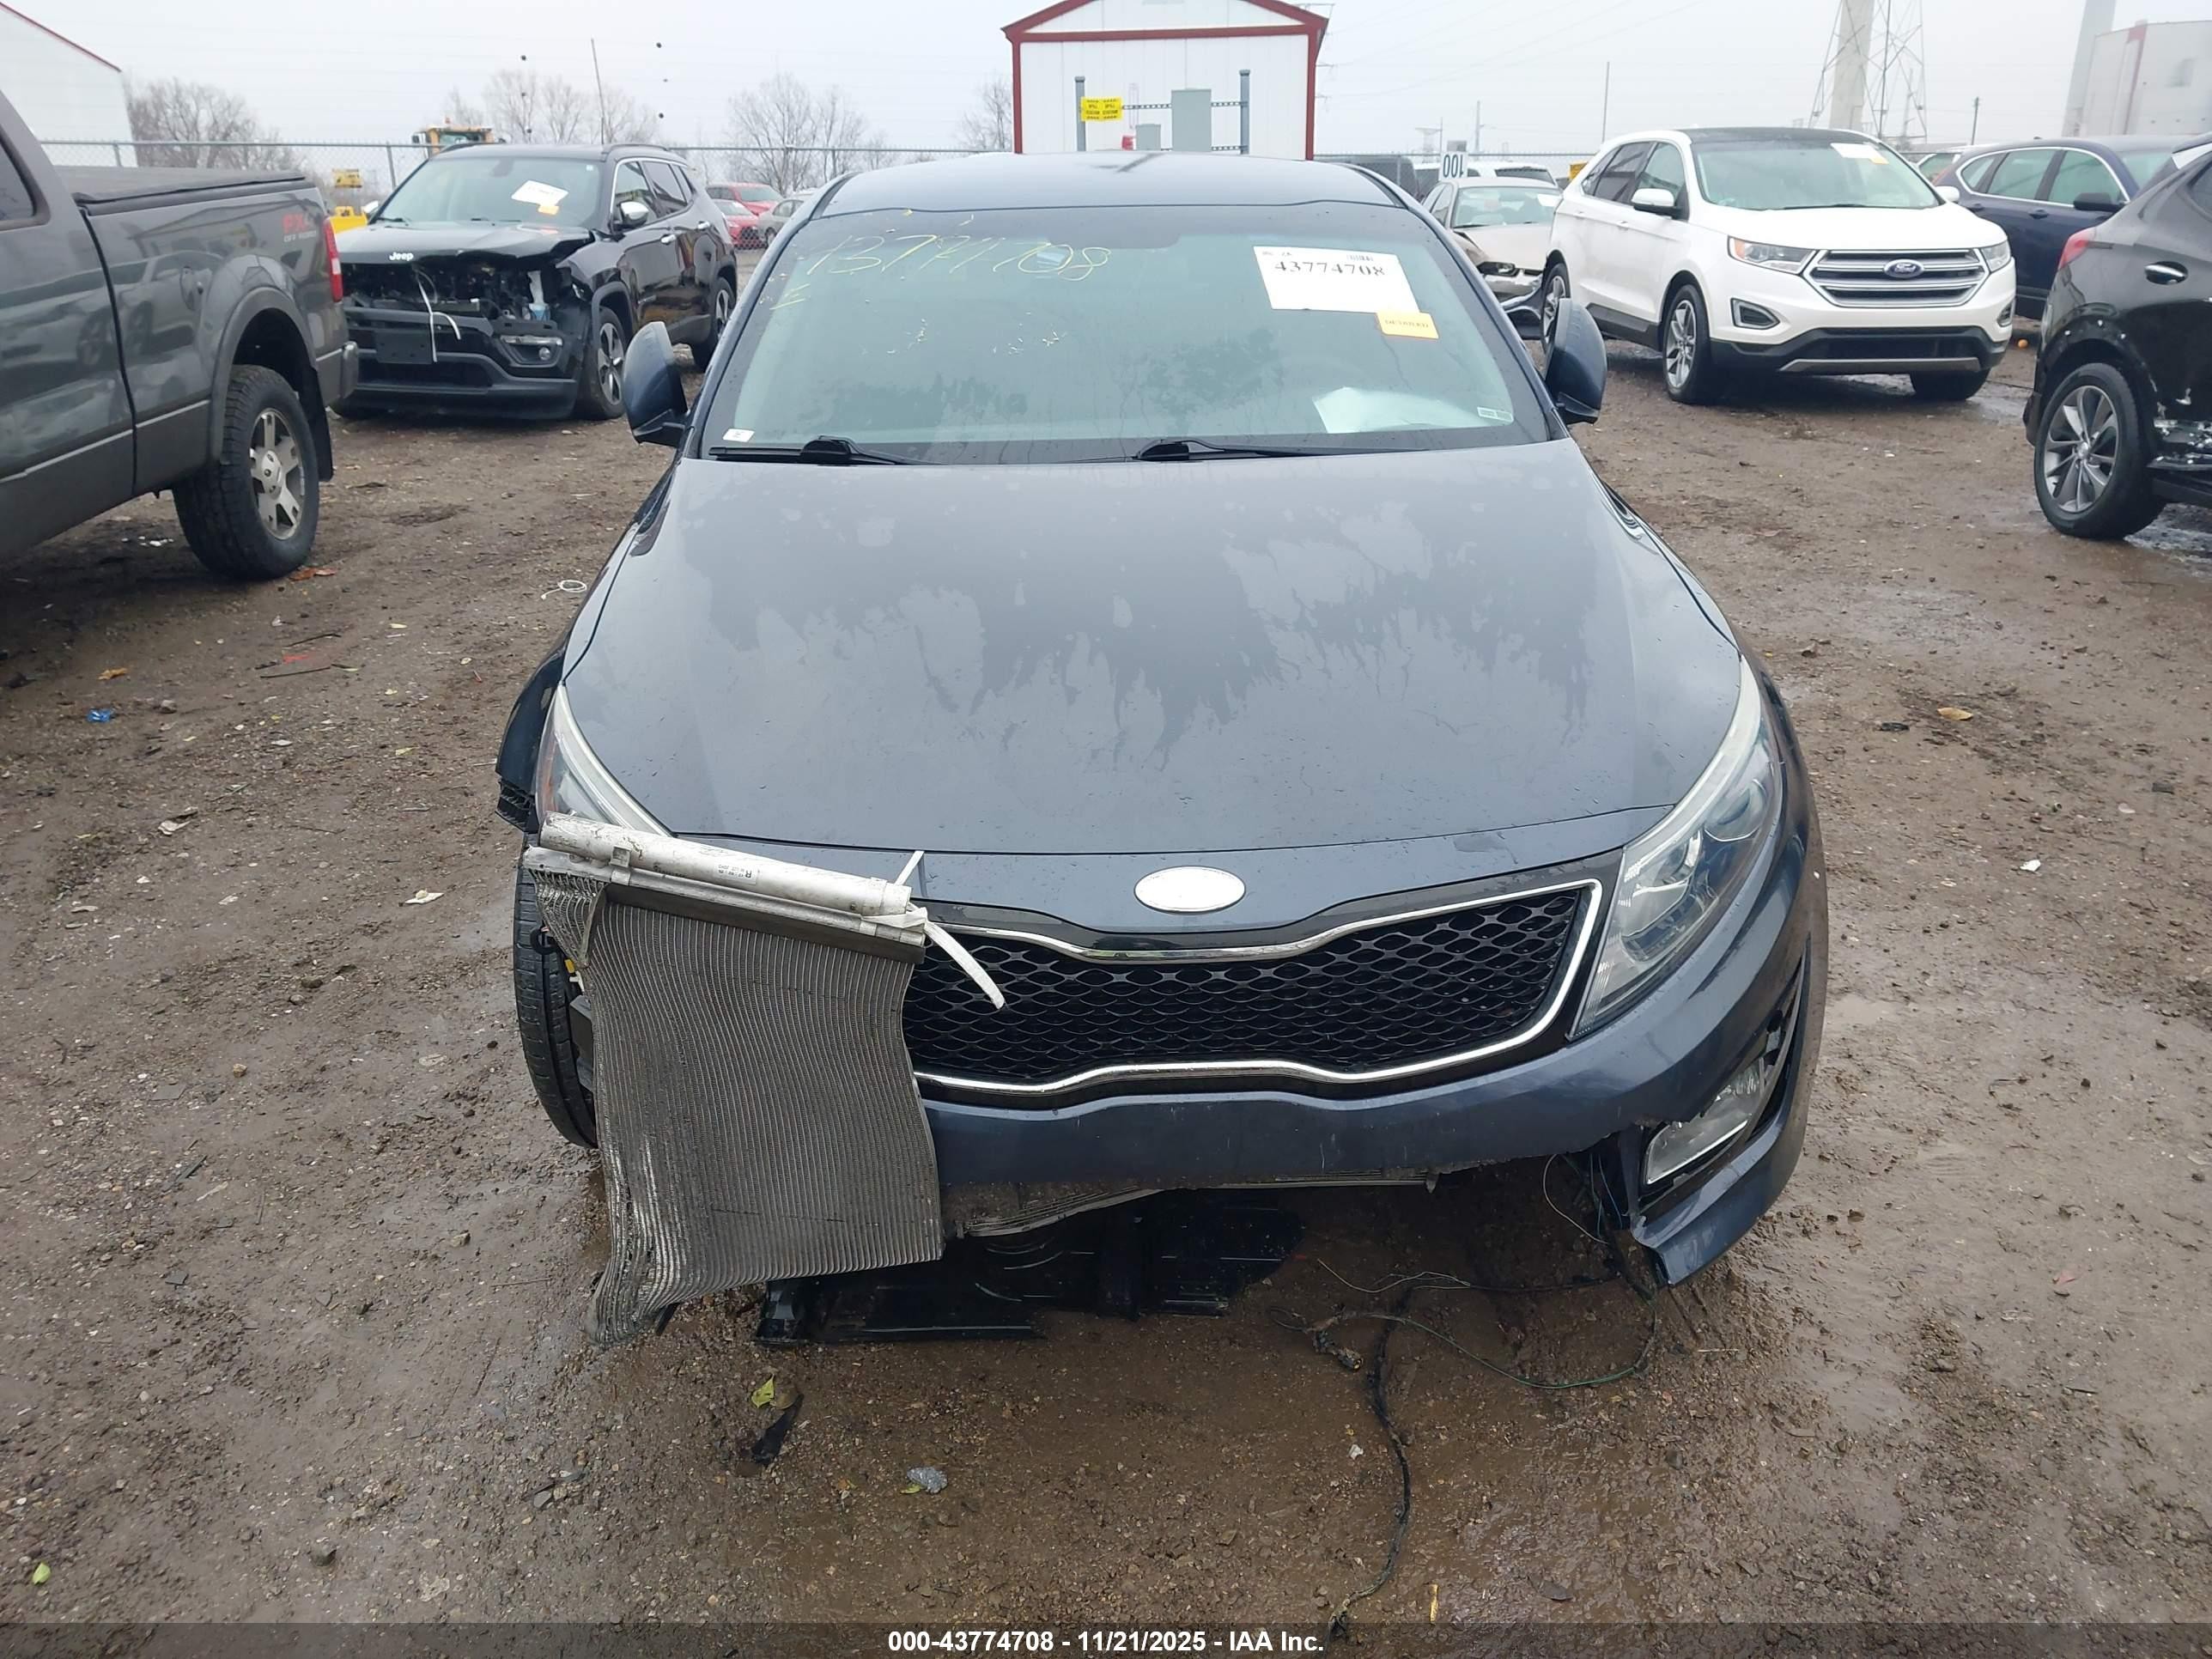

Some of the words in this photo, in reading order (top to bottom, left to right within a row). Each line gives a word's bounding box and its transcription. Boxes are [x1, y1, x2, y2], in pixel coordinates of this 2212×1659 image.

[389, 252, 414, 261] Jeep
[1274, 260, 1386, 276] 43774708
[1894, 263, 1917, 273] Ford
